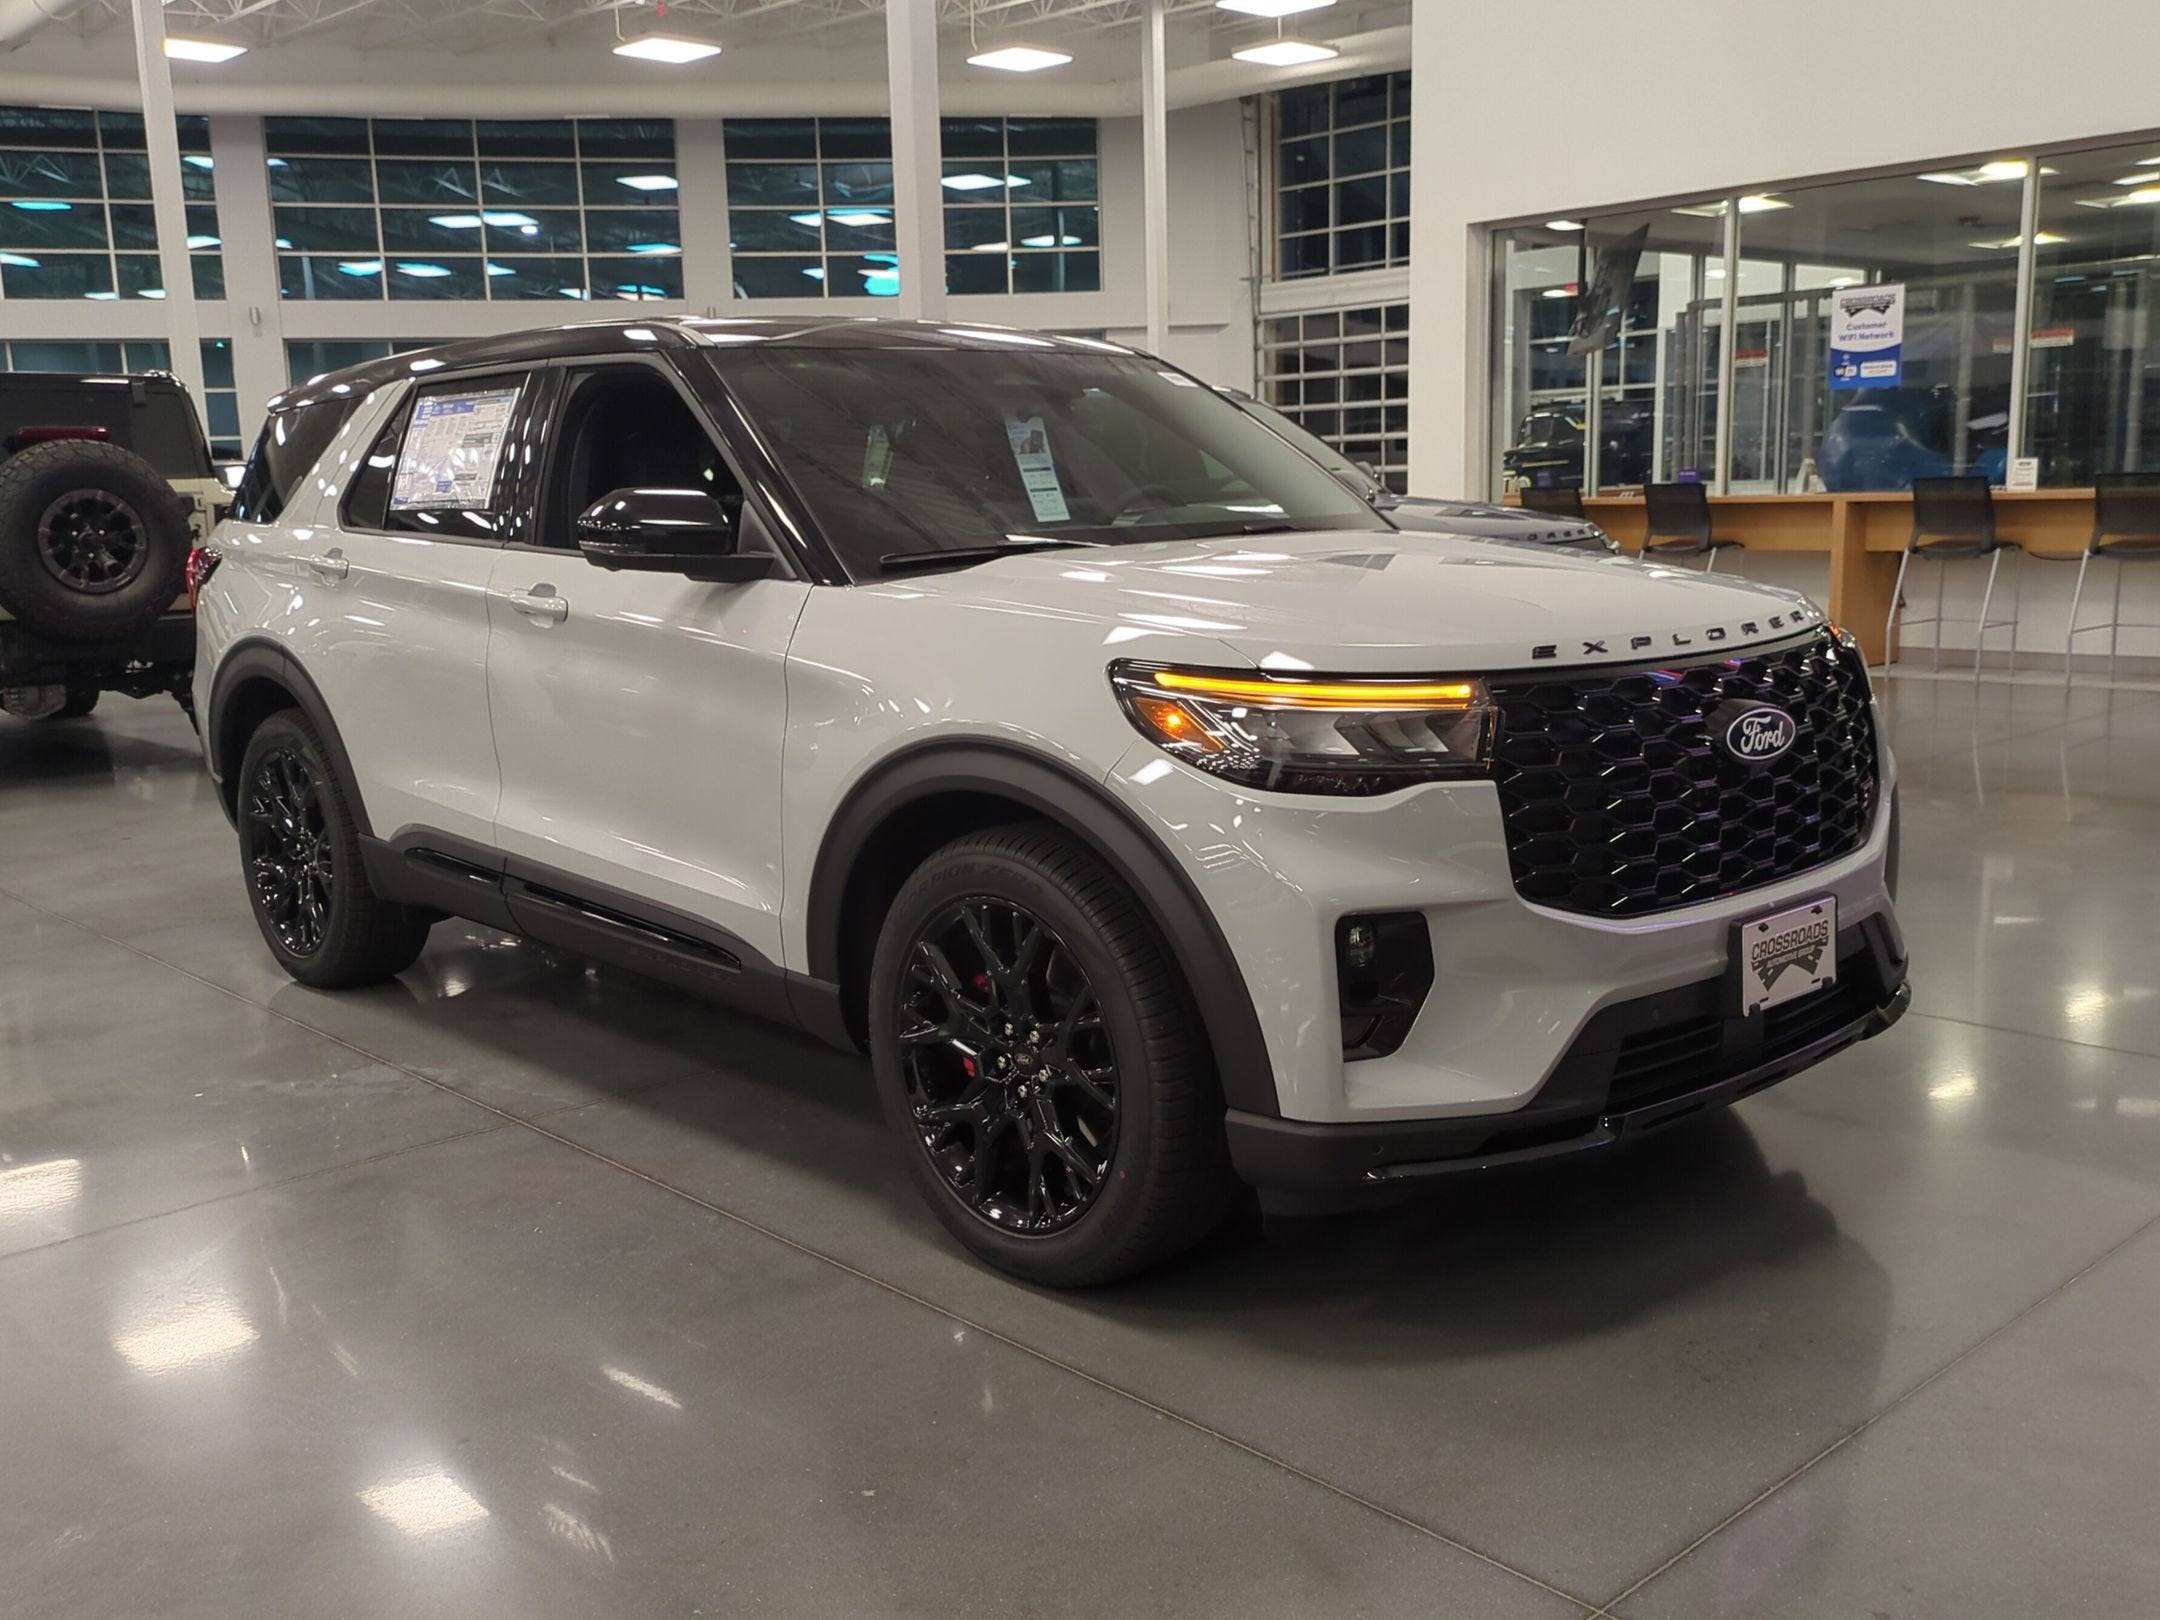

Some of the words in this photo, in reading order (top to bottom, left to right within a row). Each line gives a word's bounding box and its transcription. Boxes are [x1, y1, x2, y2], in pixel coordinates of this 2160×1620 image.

[1846, 321, 1887, 331] Customer
[1858, 331, 1895, 340] Network
[1532, 610, 1805, 660] EXPLORER
[1740, 715, 1785, 754] Ford
[1751, 920, 1829, 961] CROSSROADS
